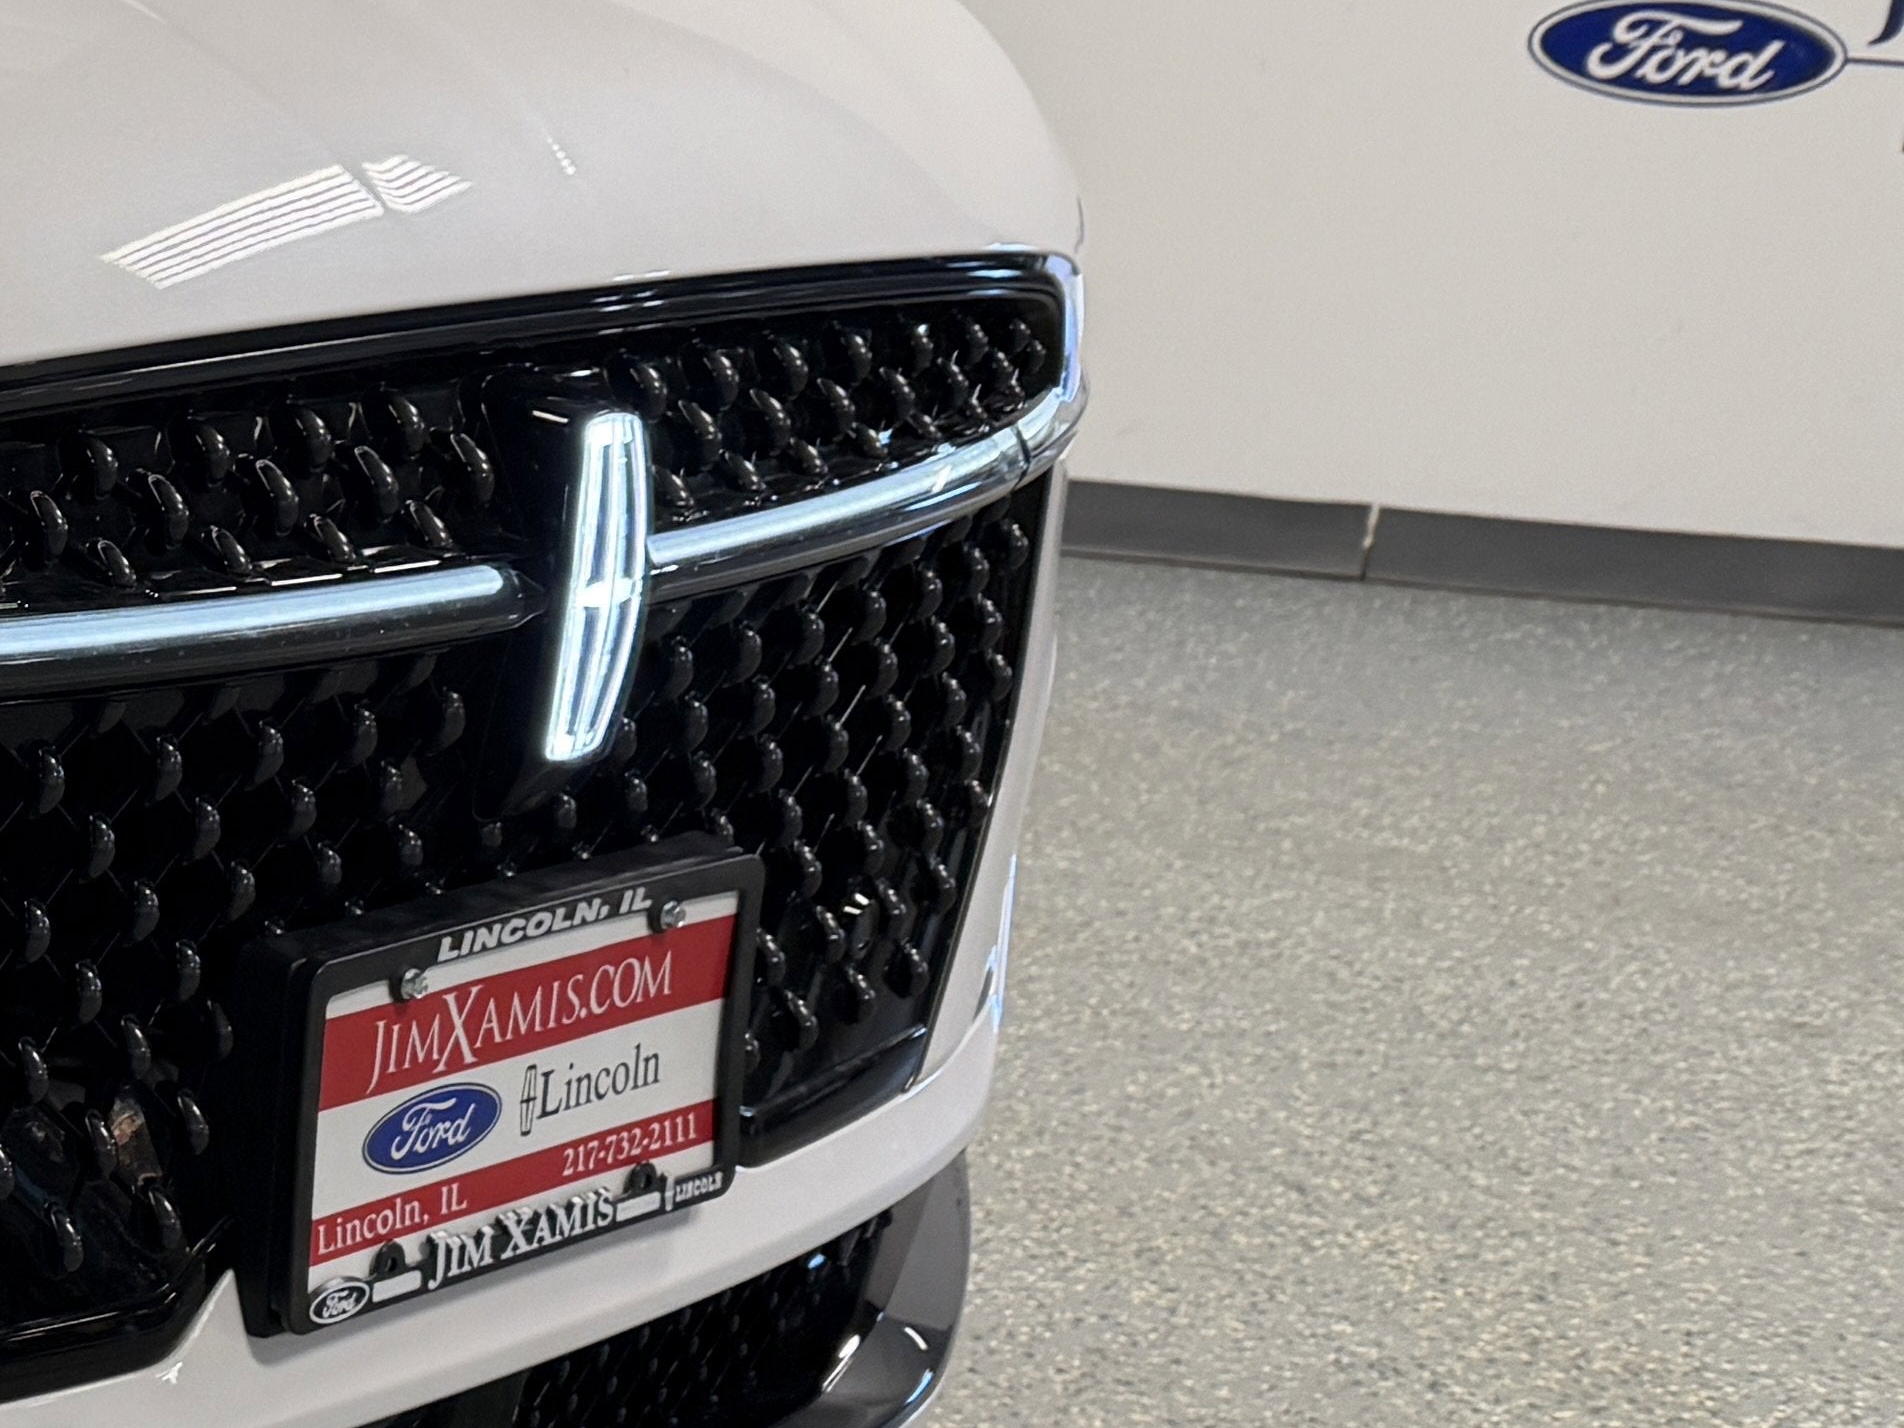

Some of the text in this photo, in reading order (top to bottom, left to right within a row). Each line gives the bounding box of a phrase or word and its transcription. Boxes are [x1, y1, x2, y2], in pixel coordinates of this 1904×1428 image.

[1586, 9, 1785, 91] Ford
[436, 886, 653, 963] LINCOLN, IL
[535, 1042, 660, 1121] Lincoln
[390, 1096, 477, 1162] Ford
[562, 1111, 698, 1177] 217-732-2111
[317, 1182, 468, 1256] Lincoln, IL
[674, 1171, 724, 1203] LINCOLN
[426, 1192, 615, 1291] JIM XAMIS
